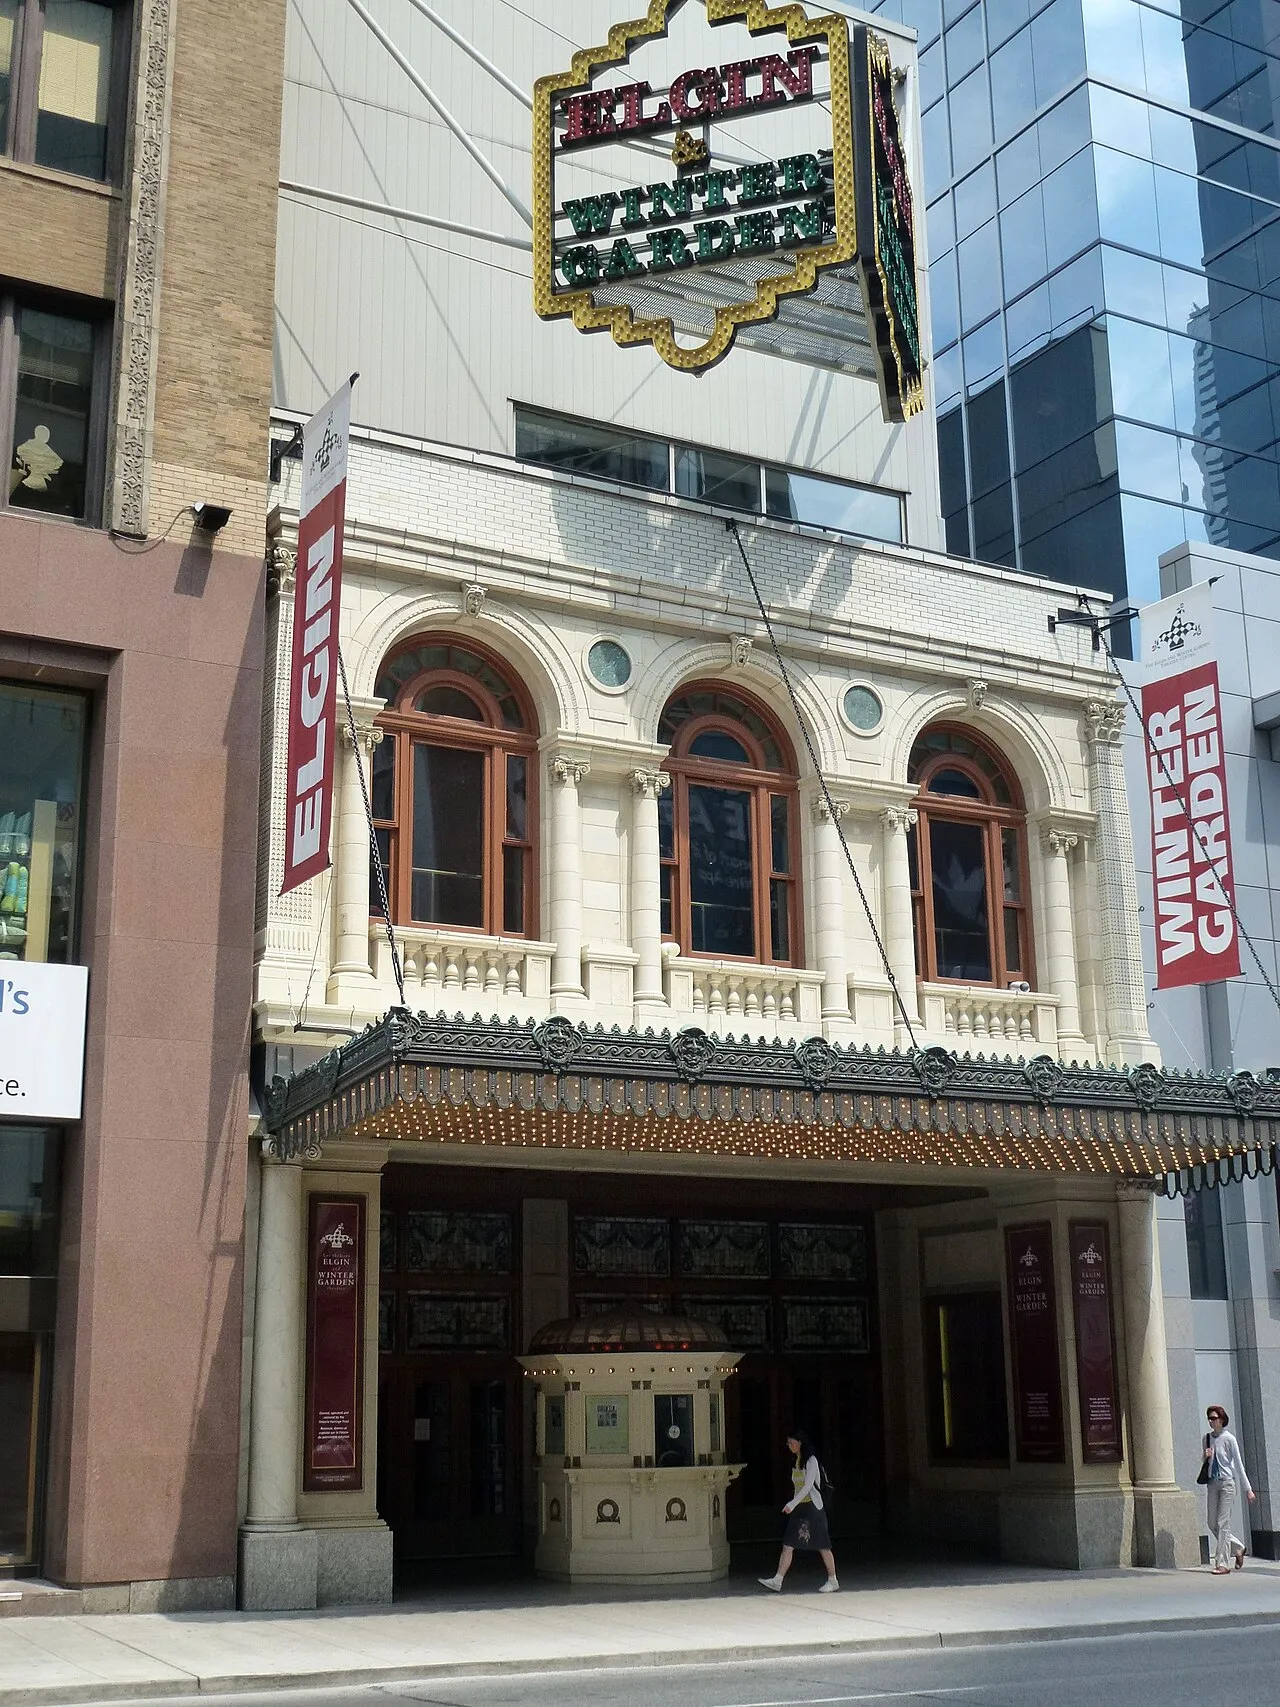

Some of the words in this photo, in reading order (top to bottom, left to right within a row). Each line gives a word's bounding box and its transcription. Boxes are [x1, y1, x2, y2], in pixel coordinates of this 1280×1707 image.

[559, 46, 820, 145] ELGIN
[561, 152, 827, 236] WINTER
[560, 199, 829, 286] GARDEN
[292, 524, 335, 868] ELGIN
[1148, 704, 1194, 967] WINTER
[1184, 683, 1234, 955] GARDEN
[0, 1078, 26, 1097] e.
[317, 1278, 355, 1286] GARDEN
[318, 1271, 354, 1279] WINTER
[1016, 1292, 1047, 1302] WINTER
[1018, 1276, 1042, 1286] ELGIN
[1016, 1301, 1048, 1311] GARDEN
